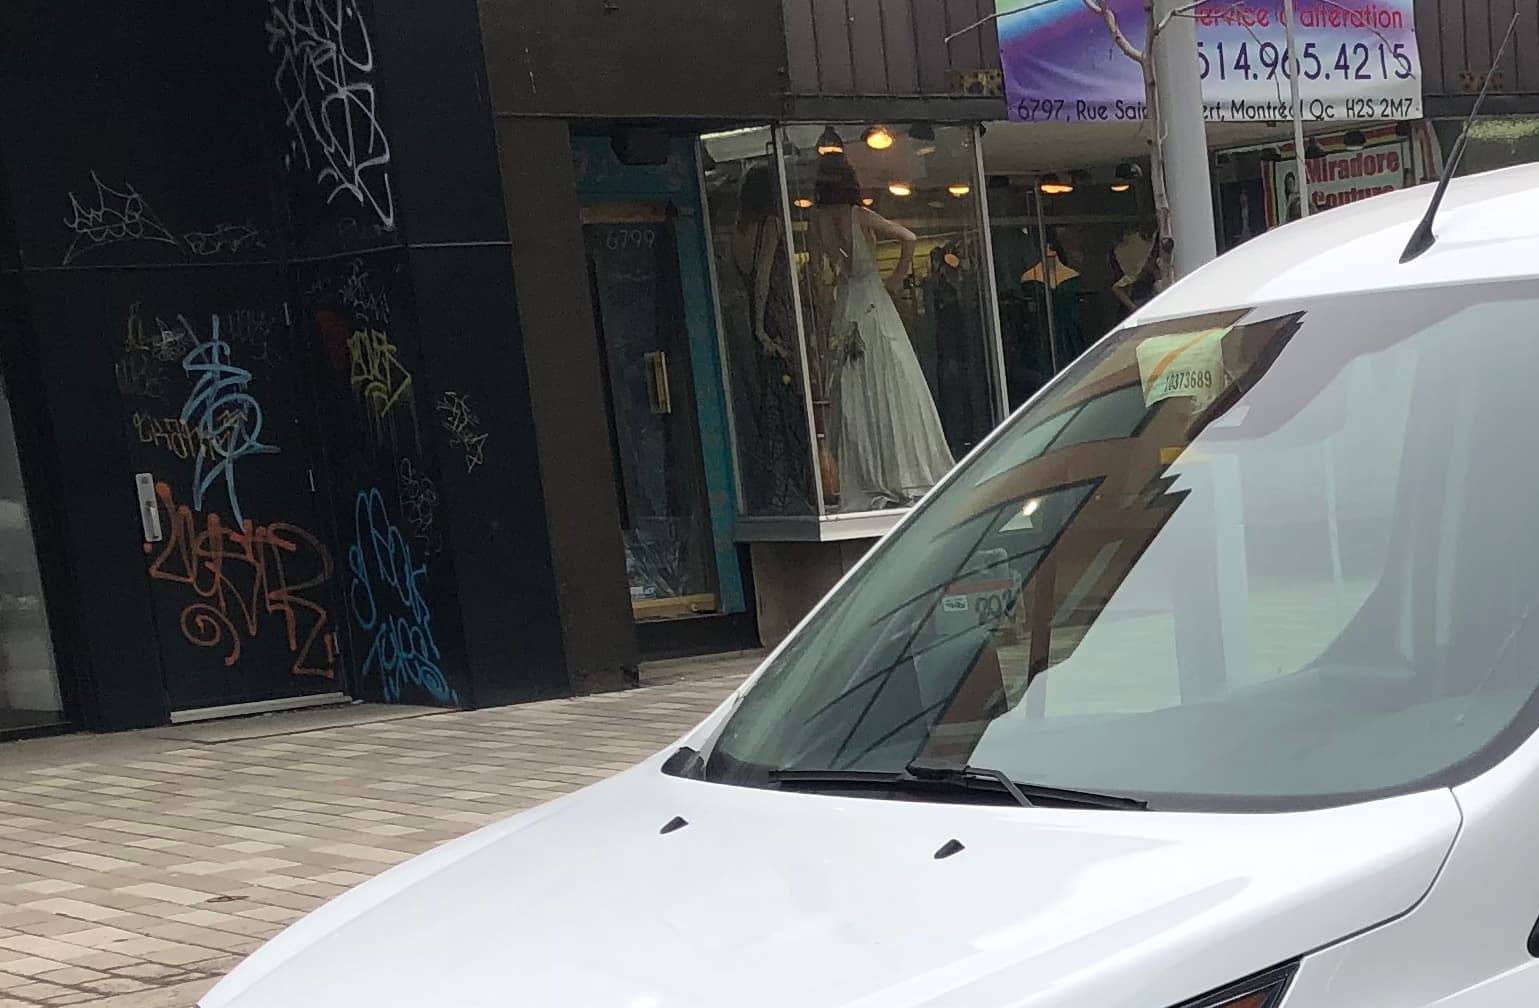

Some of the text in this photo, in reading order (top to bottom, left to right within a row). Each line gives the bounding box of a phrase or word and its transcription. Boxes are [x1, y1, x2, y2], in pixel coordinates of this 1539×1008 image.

[1195, 4, 1270, 27] ervice
[1196, 41, 1412, 80] 514.965.4215
[1017, 99, 1070, 122] 6797,
[1076, 99, 1108, 121] Rue
[1309, 98, 1335, 121] Qc
[1345, 98, 1375, 118] H2S
[1380, 97, 1413, 118] 2M7
[1305, 150, 1401, 185] Miradore
[607, 228, 656, 250] 6799
